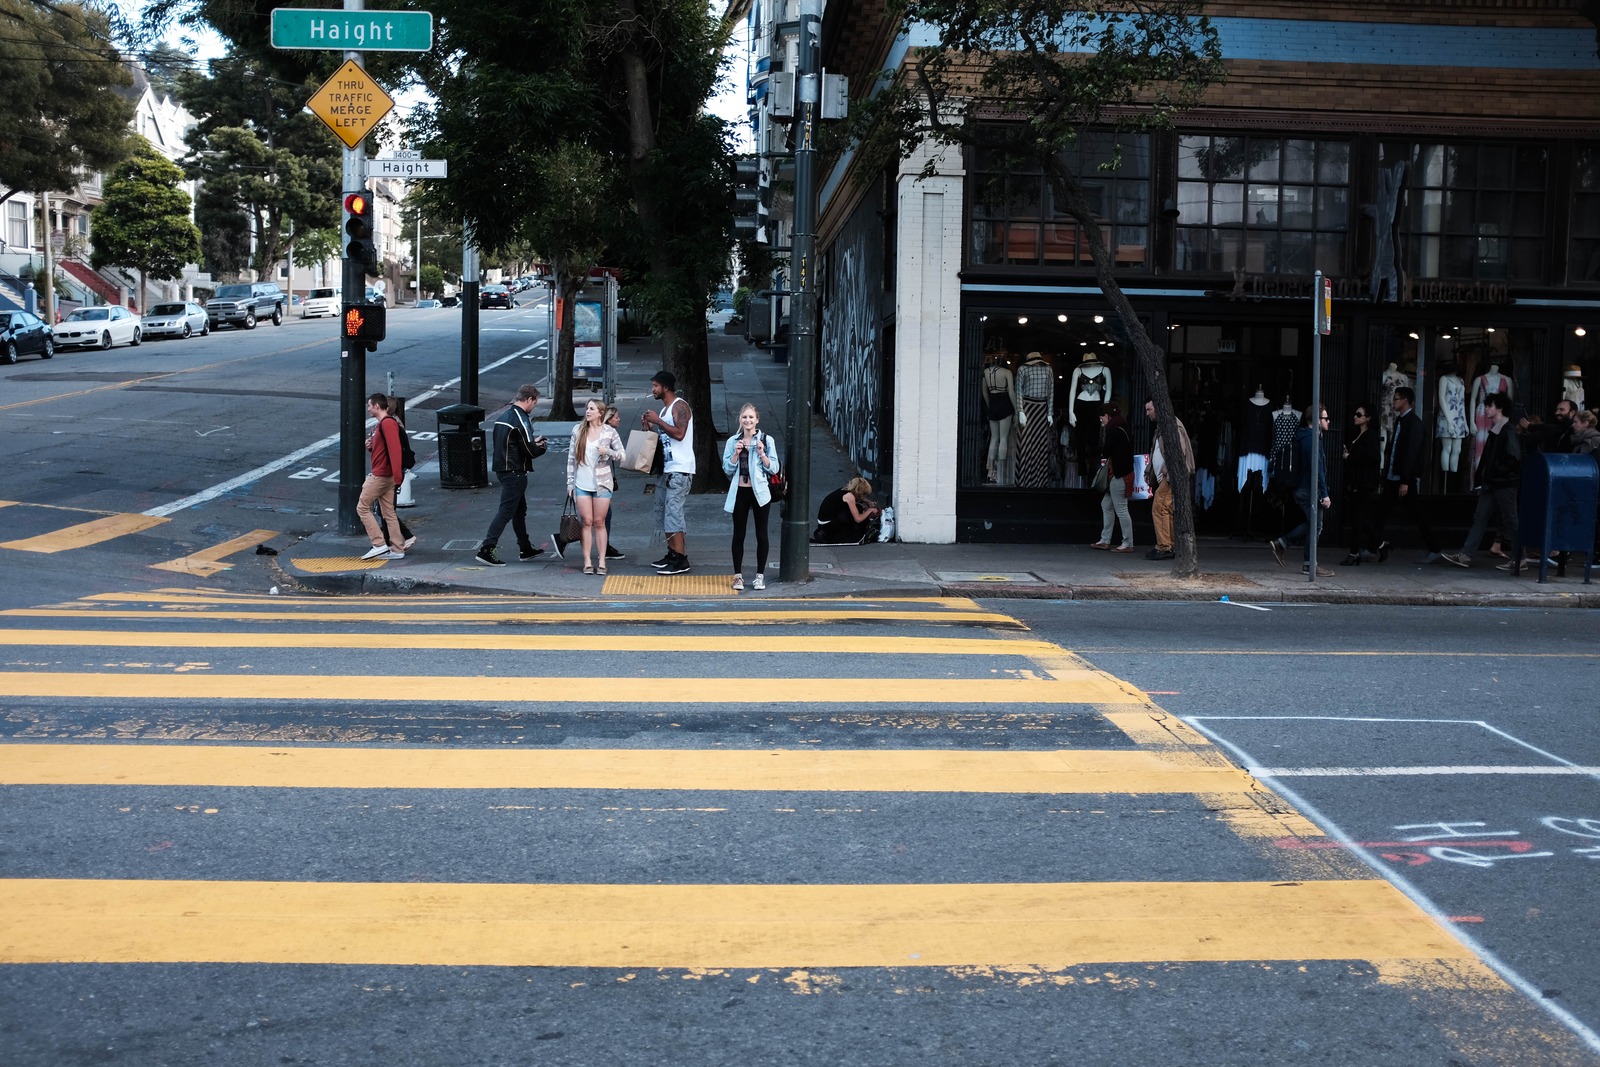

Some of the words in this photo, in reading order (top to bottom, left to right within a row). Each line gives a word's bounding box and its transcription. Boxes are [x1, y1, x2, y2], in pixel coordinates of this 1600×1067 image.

[310, 19, 393, 46] Haight
[337, 80, 364, 90] THRU
[329, 93, 373, 102] TRAFFIC
[330, 105, 372, 115] MERGE
[335, 118, 366, 127] LEFT
[383, 162, 429, 175] Haight
